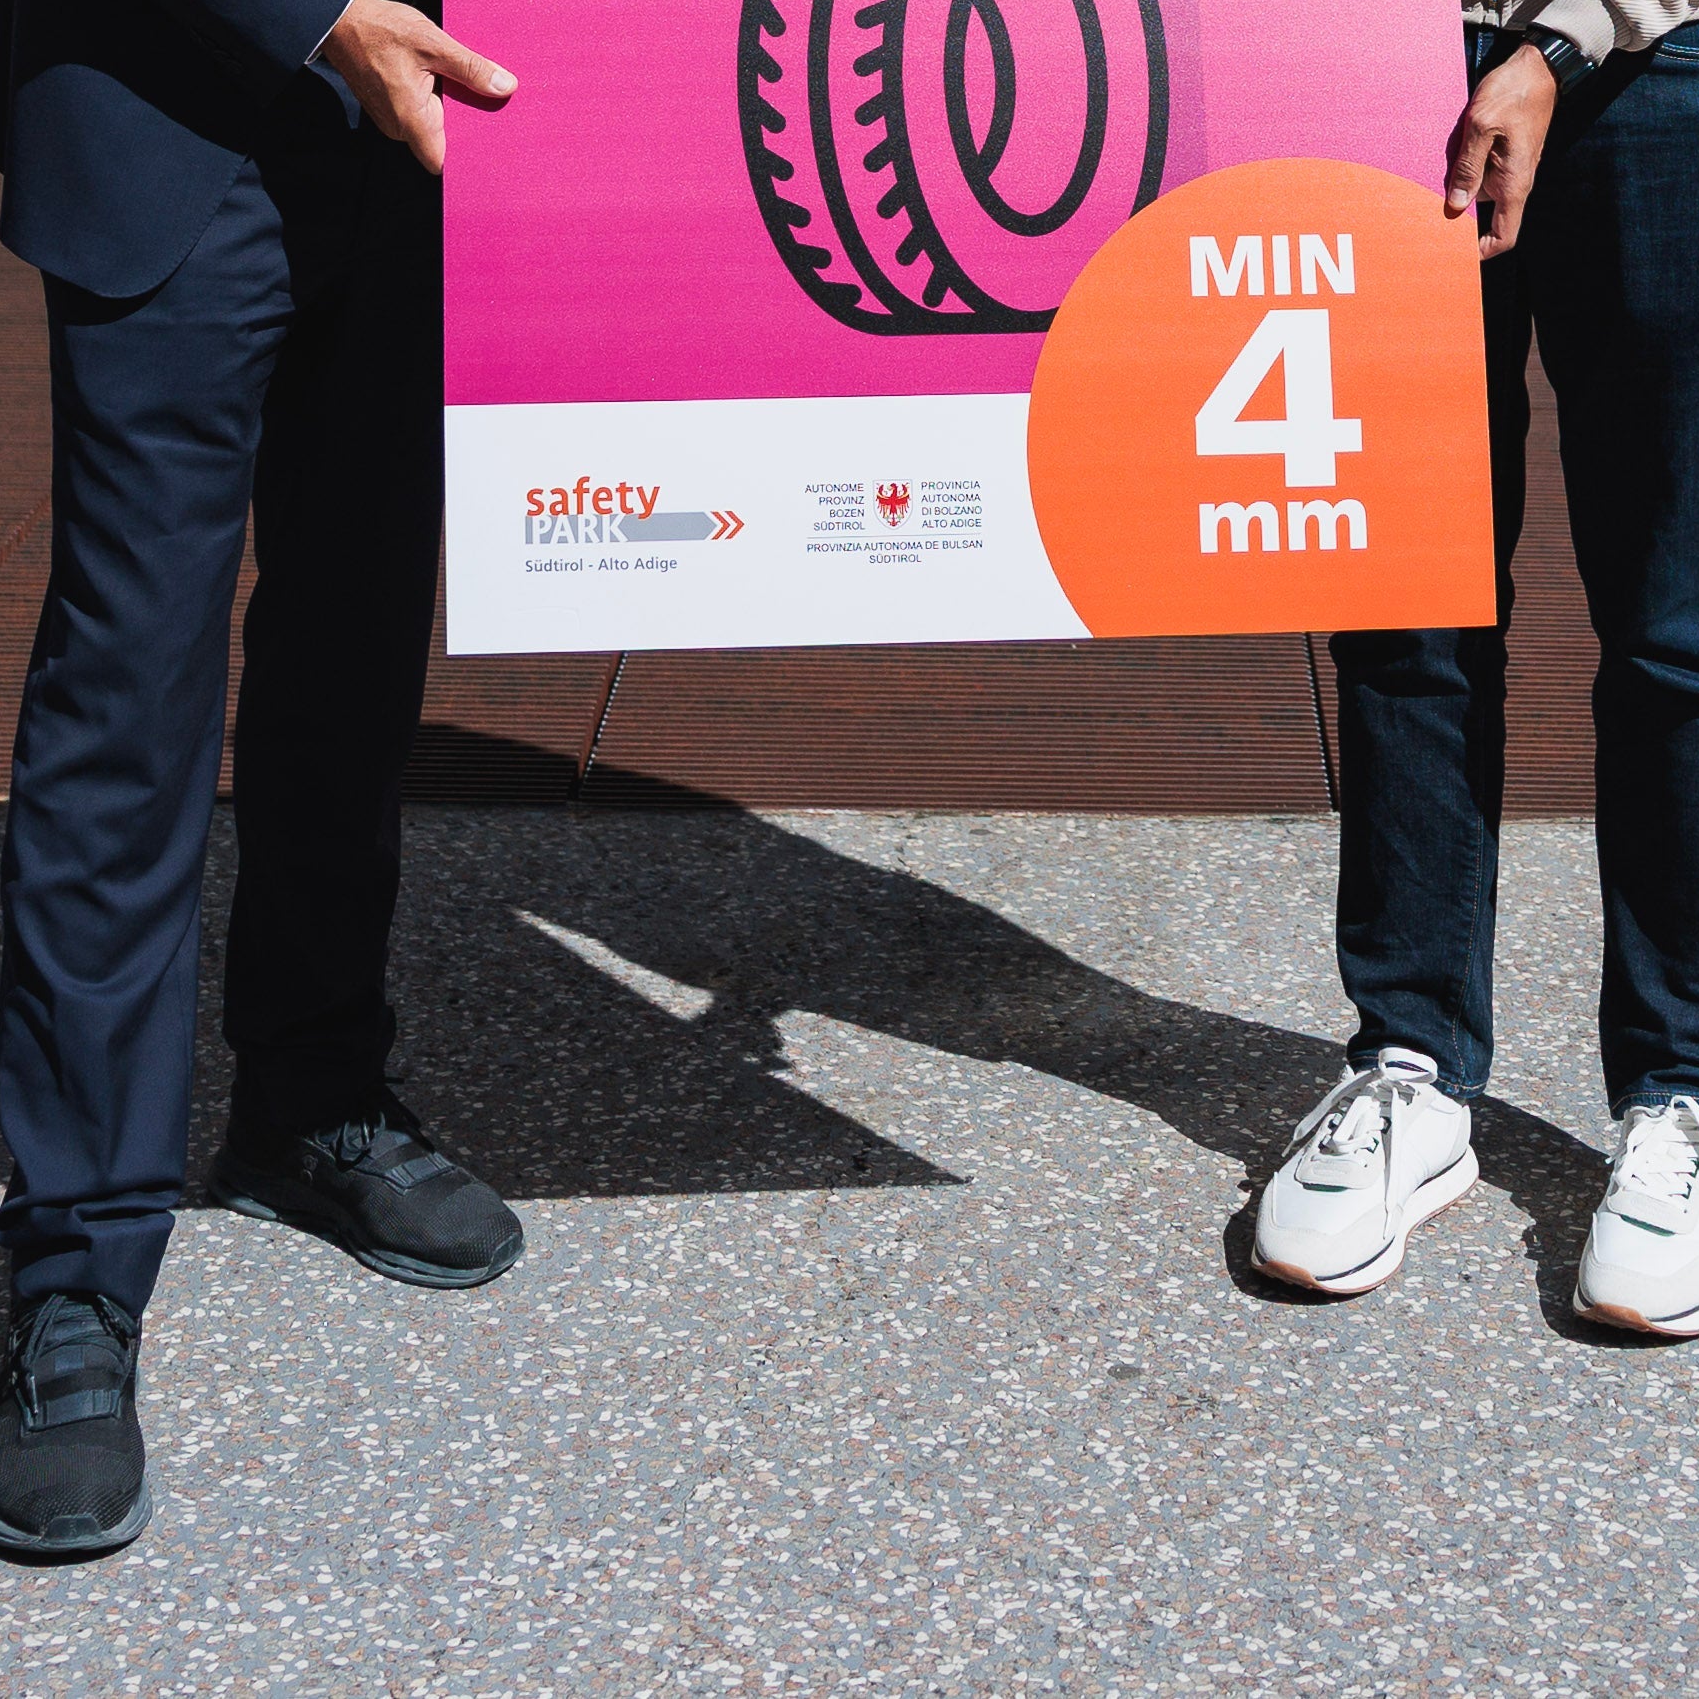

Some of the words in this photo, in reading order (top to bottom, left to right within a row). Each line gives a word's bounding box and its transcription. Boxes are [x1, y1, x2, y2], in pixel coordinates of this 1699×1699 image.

[1189, 233, 1355, 297] MIN
[1195, 308, 1363, 488] 4
[805, 483, 864, 493] AUTONOME
[921, 481, 980, 490] PROVINCIA
[526, 476, 660, 519] safety
[819, 496, 864, 505] PROVINZ
[921, 494, 981, 503] AUTONOMA
[829, 509, 864, 517] BOZEN
[922, 507, 932, 515] DI
[935, 506, 982, 515] BOLZANO
[814, 521, 865, 531] SÜDTIROL
[922, 519, 947, 528] ALTO
[950, 518, 982, 527] ADIGE
[1199, 498, 1367, 554] mm
[532, 514, 629, 543] PARK
[807, 543, 862, 552] PROVINZIA
[864, 541, 922, 551] AUTONOMA
[925, 541, 939, 550] DE
[942, 540, 983, 549] BULSAN
[869, 553, 921, 563] SÜDTIROL
[525, 559, 583, 573] Südtirol
[599, 558, 629, 571] Alto
[634, 557, 677, 573] Adige
